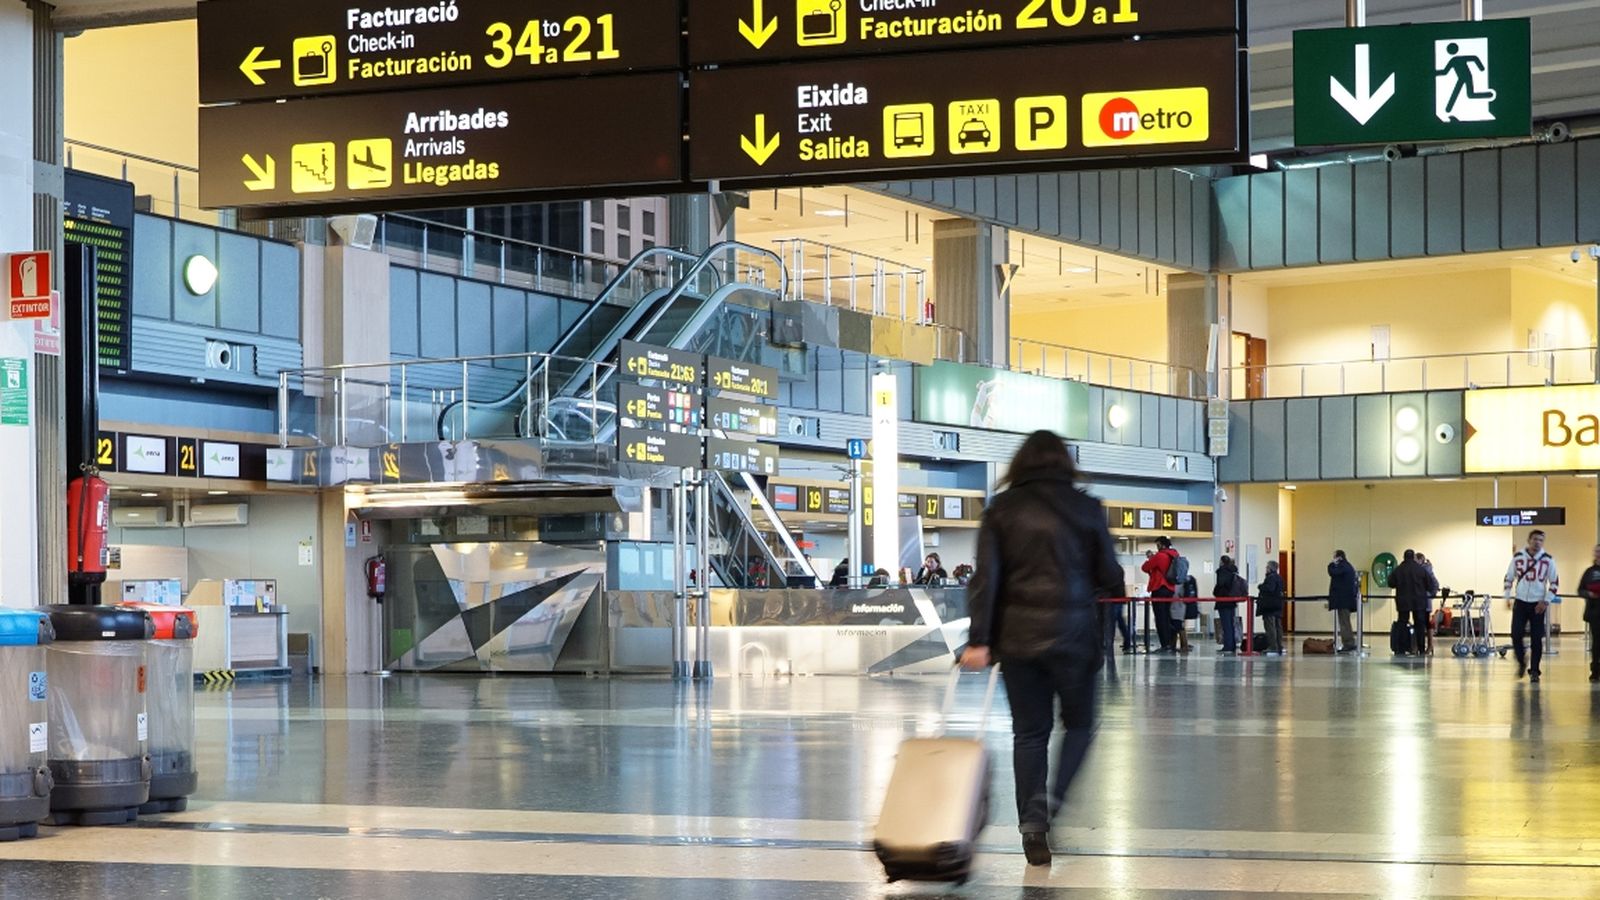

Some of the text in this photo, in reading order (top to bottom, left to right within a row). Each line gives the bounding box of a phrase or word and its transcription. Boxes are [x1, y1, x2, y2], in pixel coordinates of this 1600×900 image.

[347, 0, 459, 30] Facturació
[860, 9, 1002, 40] Facturación
[1092, 6, 1107, 25] a
[347, 31, 415, 54] Check-in
[484, 13, 620, 69] 34 to a 21
[348, 51, 472, 79] Facturación
[797, 82, 868, 109] Eixida
[403, 107, 509, 134] Arribades
[798, 112, 833, 133] Exit
[959, 104, 989, 116] TAXI
[1112, 107, 1193, 132] metro
[1029, 106, 1055, 142] P
[403, 135, 466, 158] Arrivals
[798, 135, 870, 161] Salida
[403, 158, 500, 187] Llegadas
[12, 302, 49, 314] EXTINTOR
[1543, 409, 1600, 447] Ba
[98, 438, 113, 465] 2
[180, 444, 196, 470] 21
[808, 491, 821, 509] 19
[927, 498, 938, 515] 17
[1163, 513, 1173, 527] 13
[852, 603, 905, 614] Información
